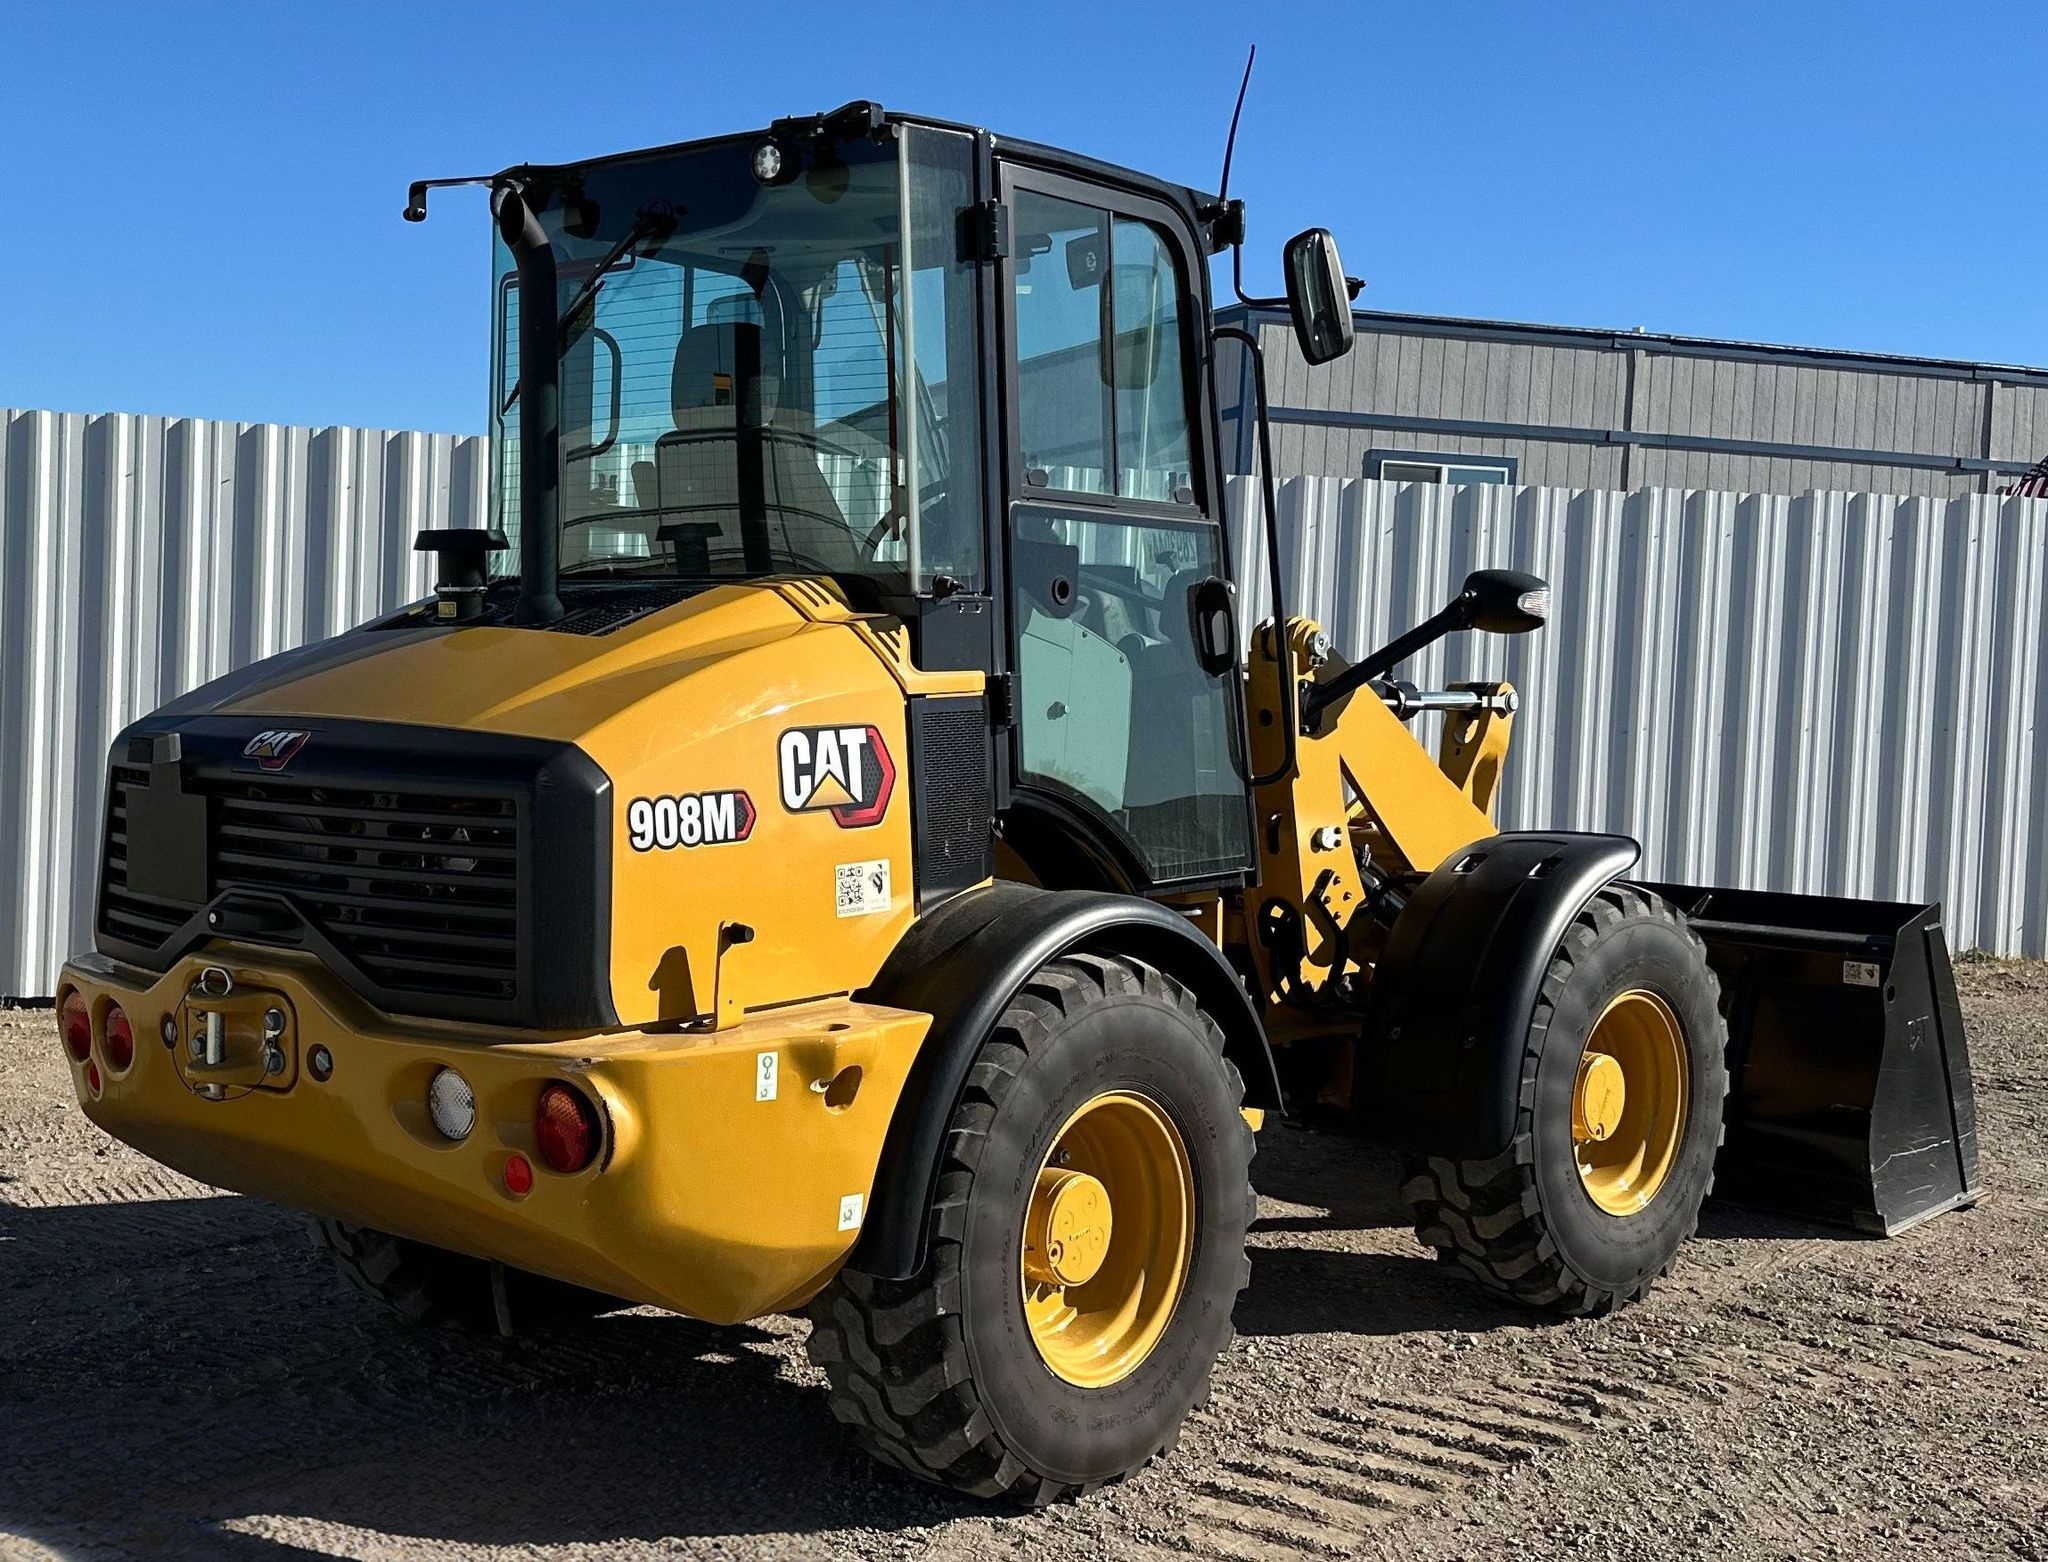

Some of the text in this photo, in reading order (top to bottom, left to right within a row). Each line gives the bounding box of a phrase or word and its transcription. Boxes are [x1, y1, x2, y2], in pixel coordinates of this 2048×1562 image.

[243, 731, 303, 757] CAT
[780, 728, 867, 809] CAT
[629, 793, 736, 849] 908M
